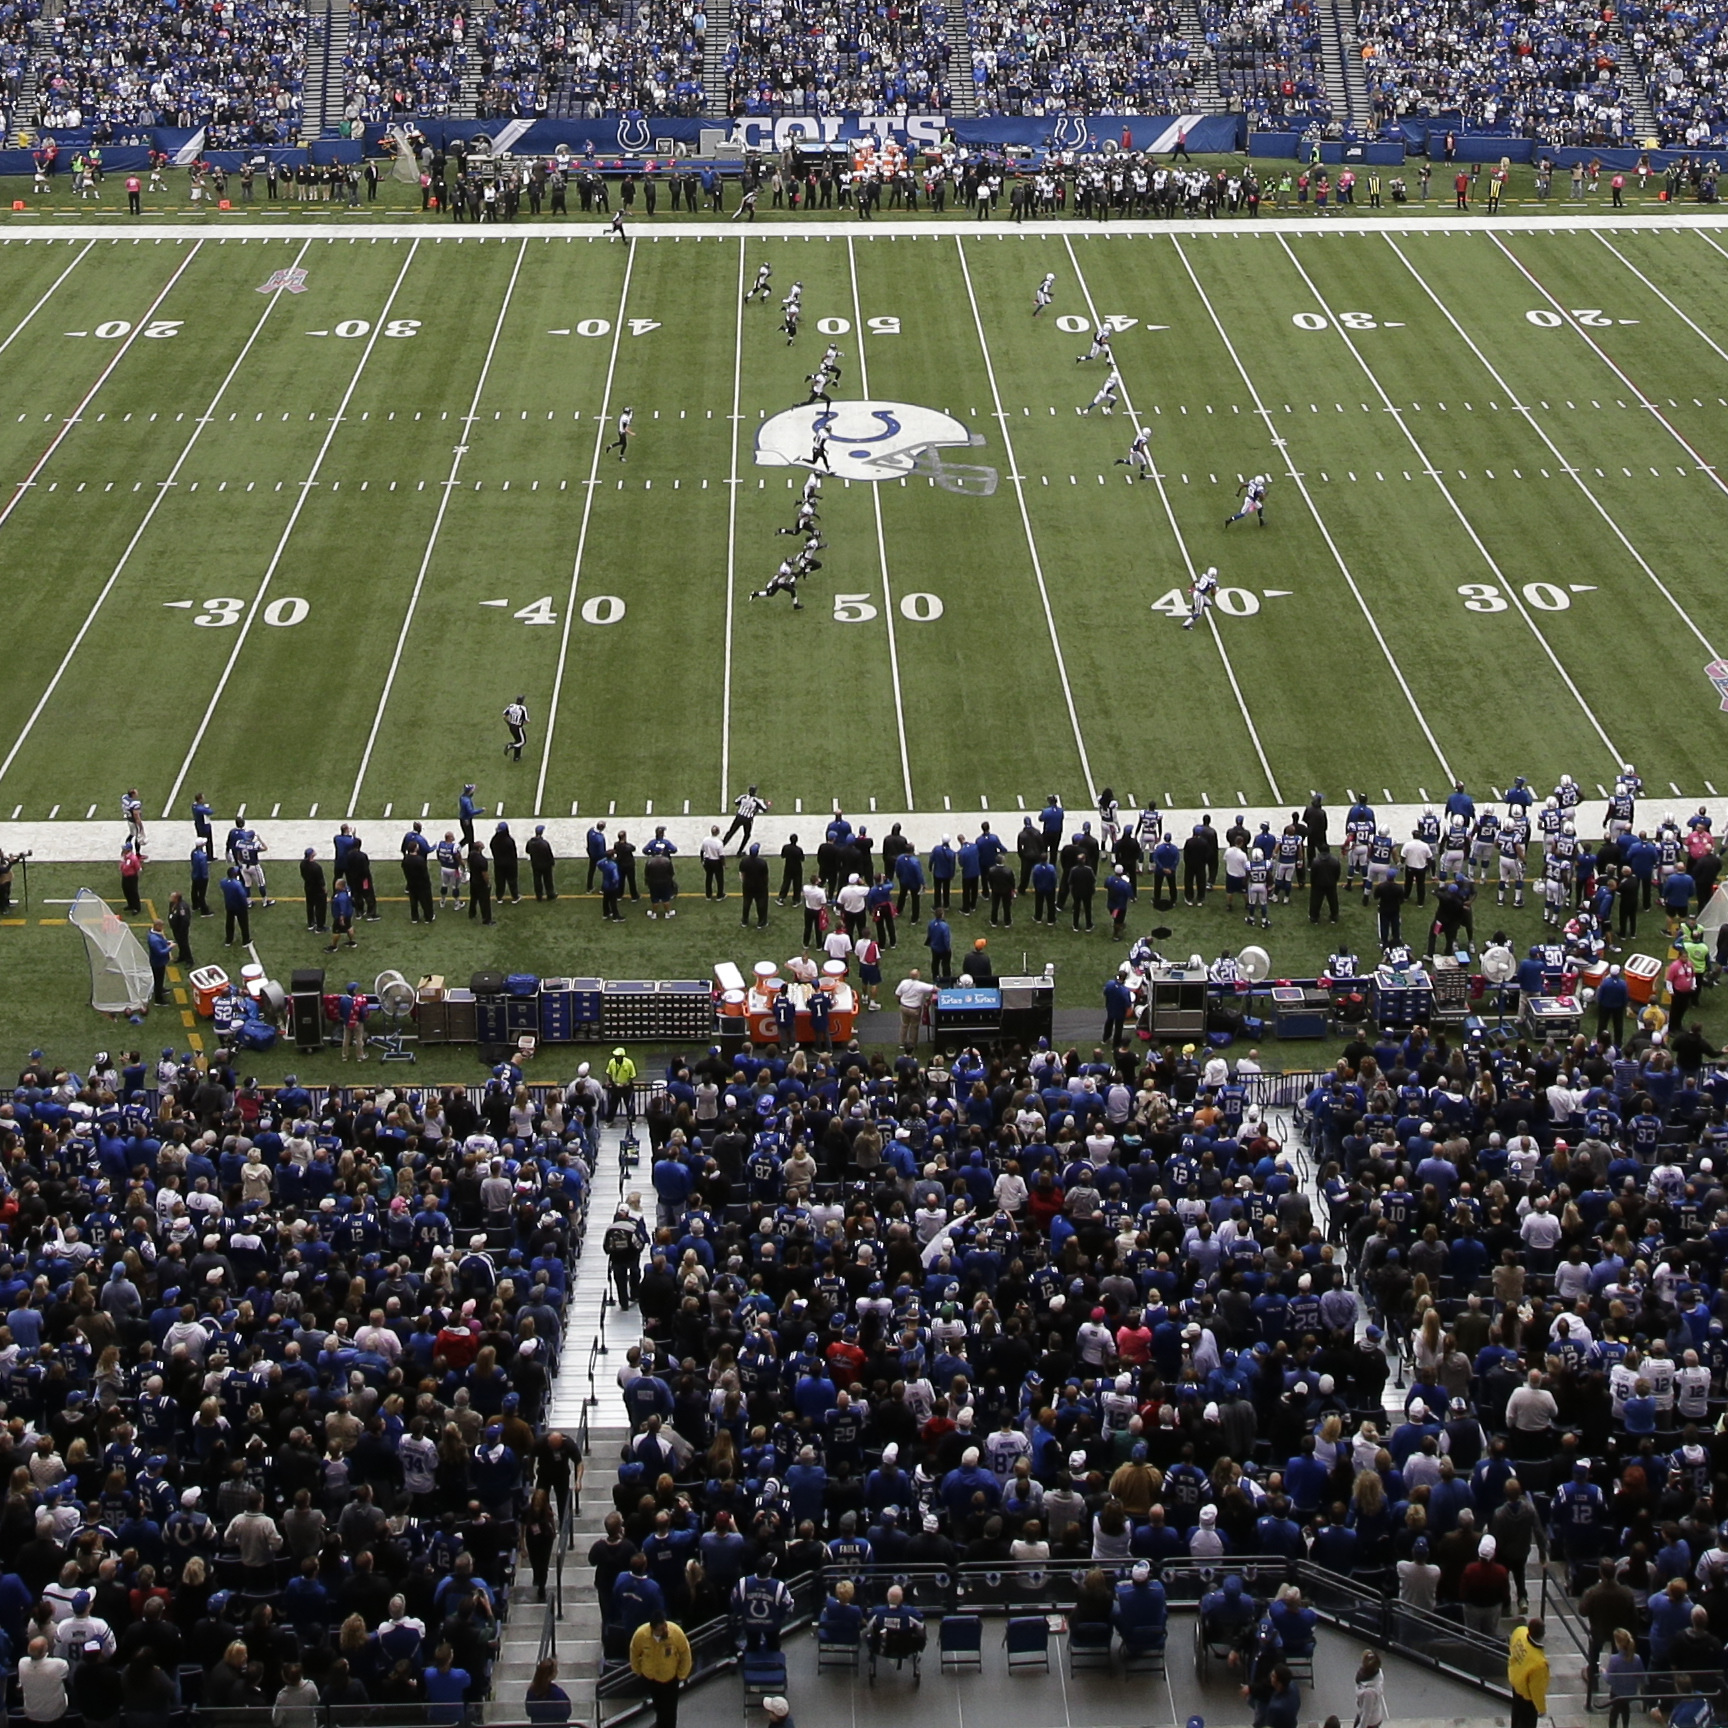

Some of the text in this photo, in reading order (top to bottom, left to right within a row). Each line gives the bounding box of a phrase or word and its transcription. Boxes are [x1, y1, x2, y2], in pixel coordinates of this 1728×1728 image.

[734, 116, 946, 152] COLTS
[195, 596, 311, 629] 30
[513, 594, 627, 626] 40
[832, 592, 947, 623] 50
[1151, 586, 1263, 617] 40
[1457, 582, 1571, 612] 30
[1544, 951, 1562, 965] 90
[213, 1005, 233, 1021] 52
[941, 994, 997, 1006] Surface Surface
